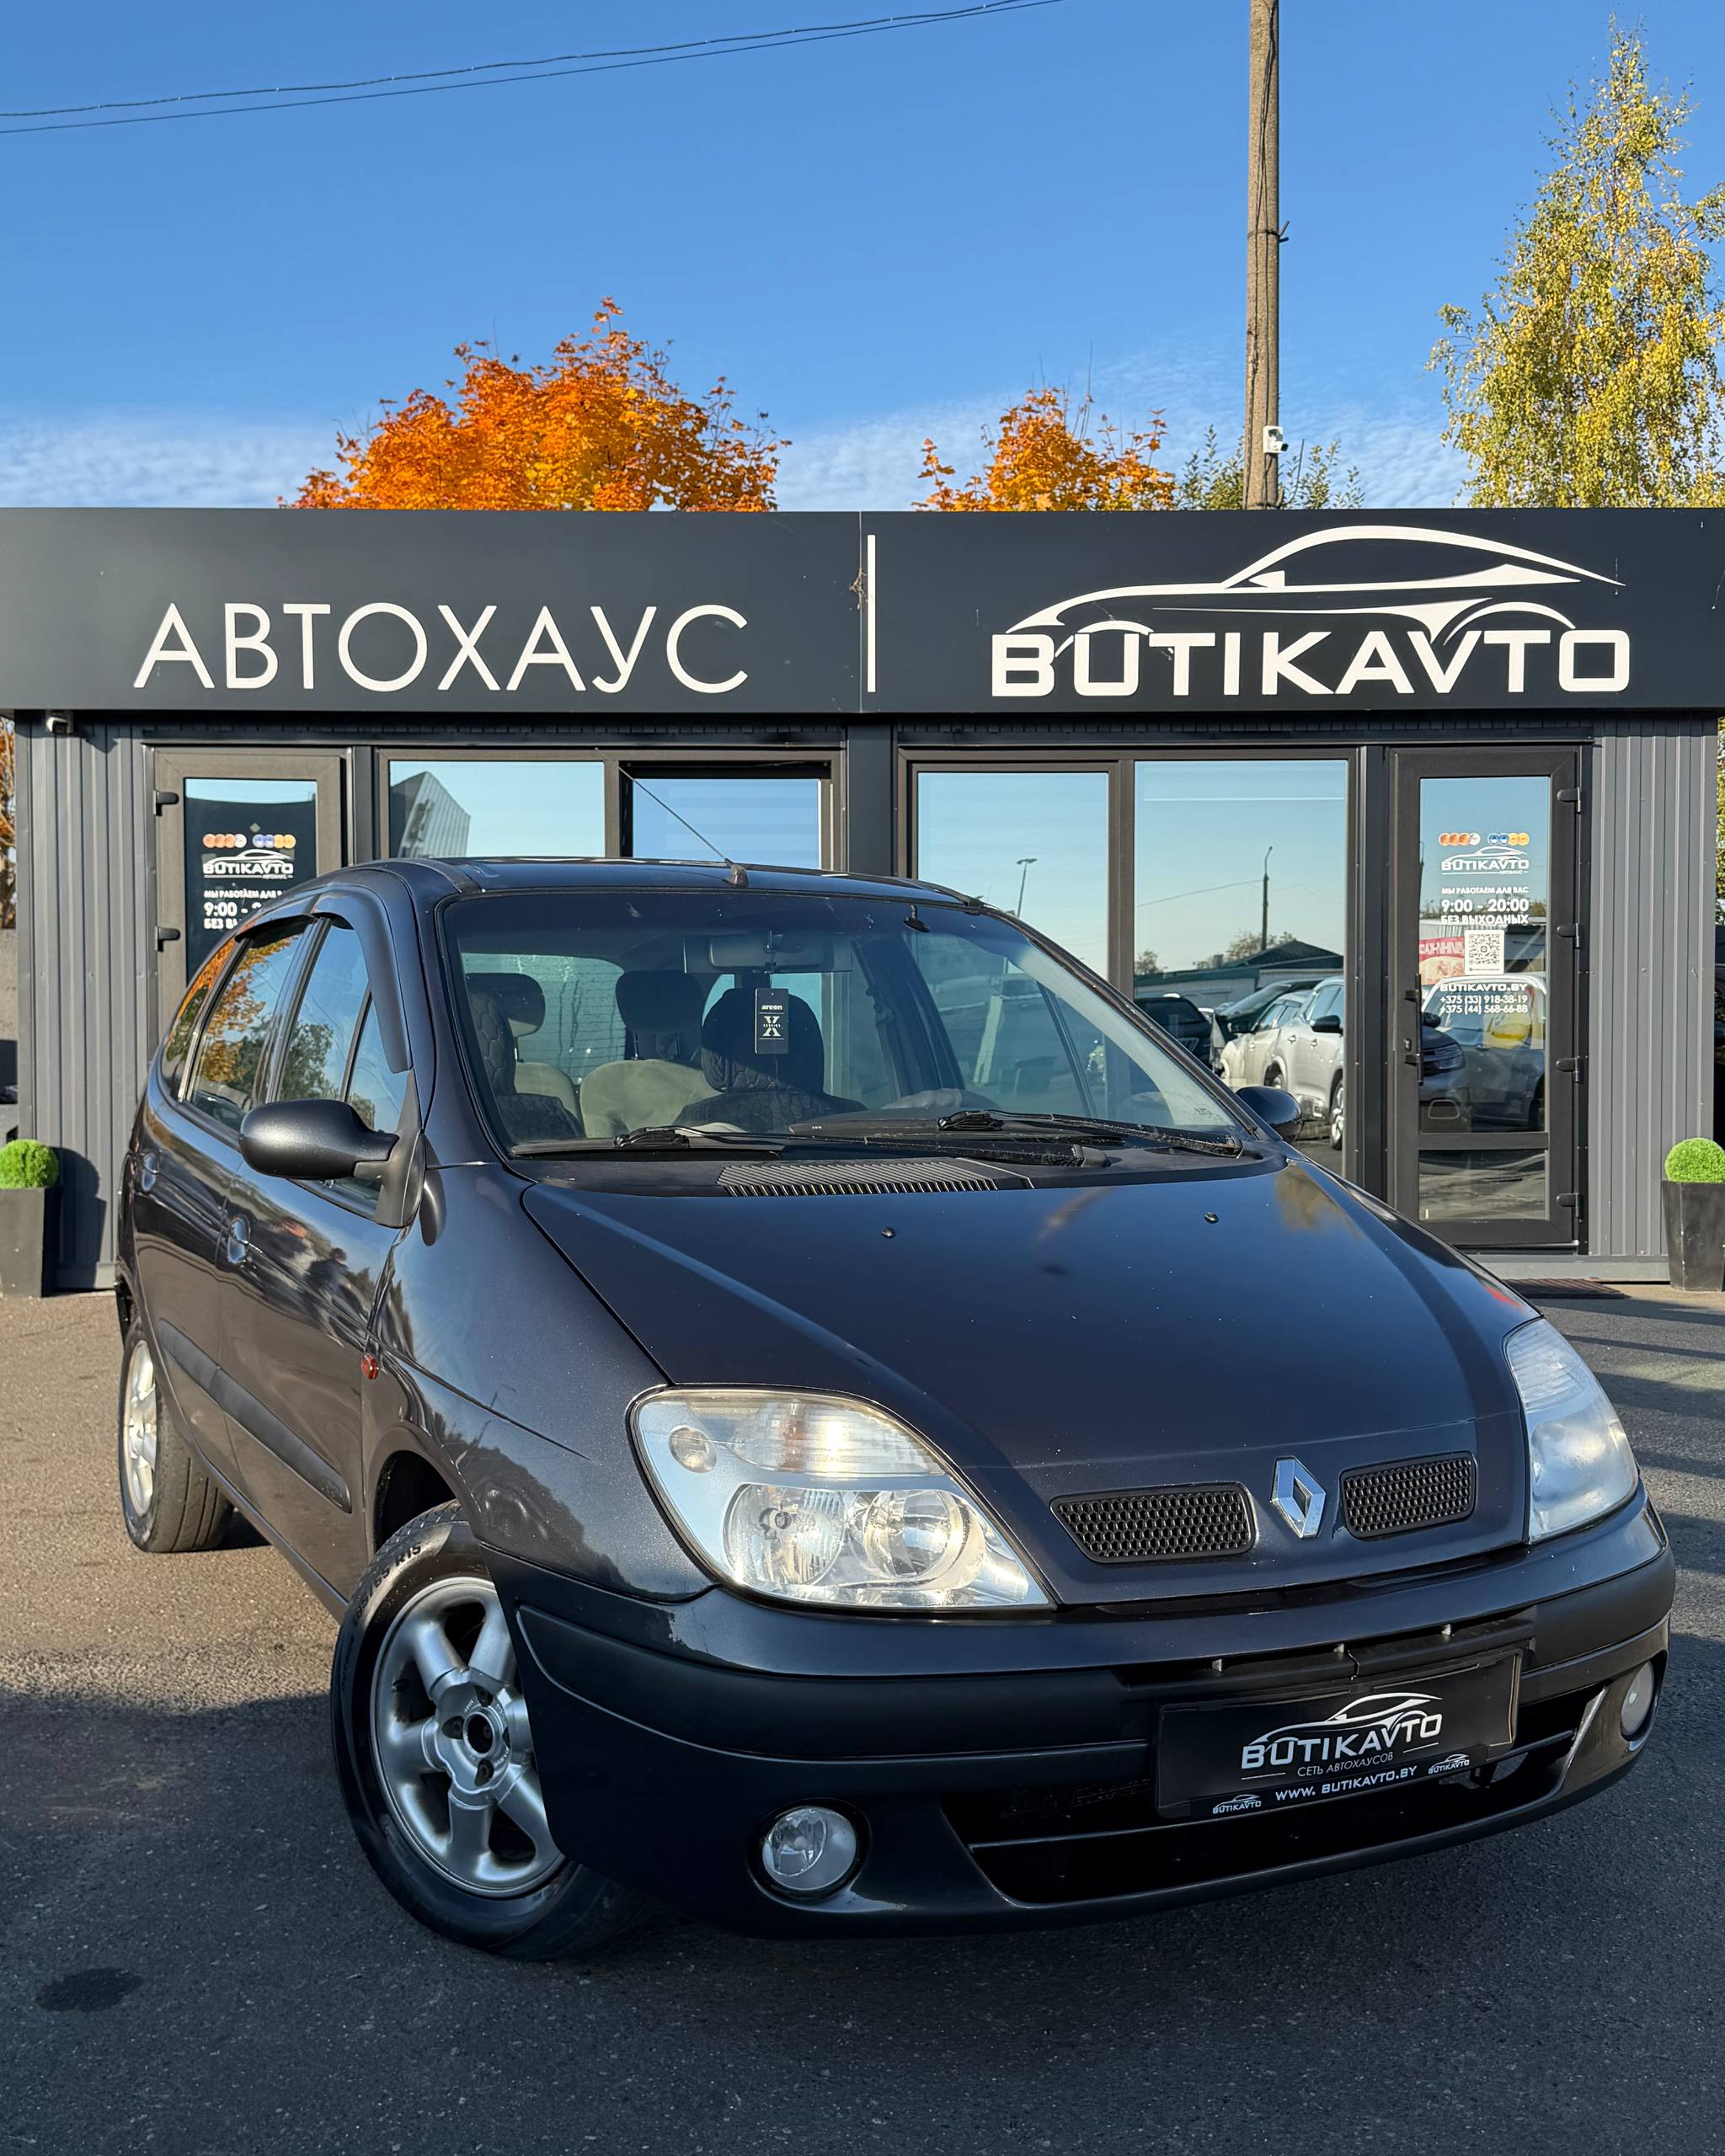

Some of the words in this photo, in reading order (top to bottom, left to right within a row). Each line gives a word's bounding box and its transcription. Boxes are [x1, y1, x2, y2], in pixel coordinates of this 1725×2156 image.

[134, 603, 747, 693] АВТОХАУС
[992, 627, 1630, 696] BUTIKAVTO
[203, 862, 293, 874] BUTIKAVTO
[1441, 859, 1529, 871] BUTIKAVTO
[204, 902, 238, 917] 9:00
[1441, 899, 1473, 912] 9:00
[1487, 898, 1529, 912] 20:00
[204, 917, 224, 930] БЕЗ
[1440, 915, 1460, 925] БЕЗ
[1461, 914, 1529, 926] ВЫХОДНЫХ
[1439, 983, 1528, 992] BUTIKAVTO.BY
[1440, 995, 1463, 1004] +375
[1465, 995, 1482, 1006] (33)
[1483, 995, 1528, 1004] 918-38-19
[1440, 1005, 1463, 1013] +375
[1465, 1005, 1482, 1015] (44)
[1242, 1713, 1443, 1769] BUTIKAVTO
[1297, 1765, 1323, 1777] СЕТЬ
[1326, 1751, 1393, 1774] АВТОХАУСОВ
[1428, 1759, 1470, 1774] BUTIKAVTO
[1275, 1785, 1316, 1801] WWW.
[1322, 1766, 1418, 1794] BUTIKAVTO.BY
[1213, 1801, 1262, 1814] BUTIKAVTO
